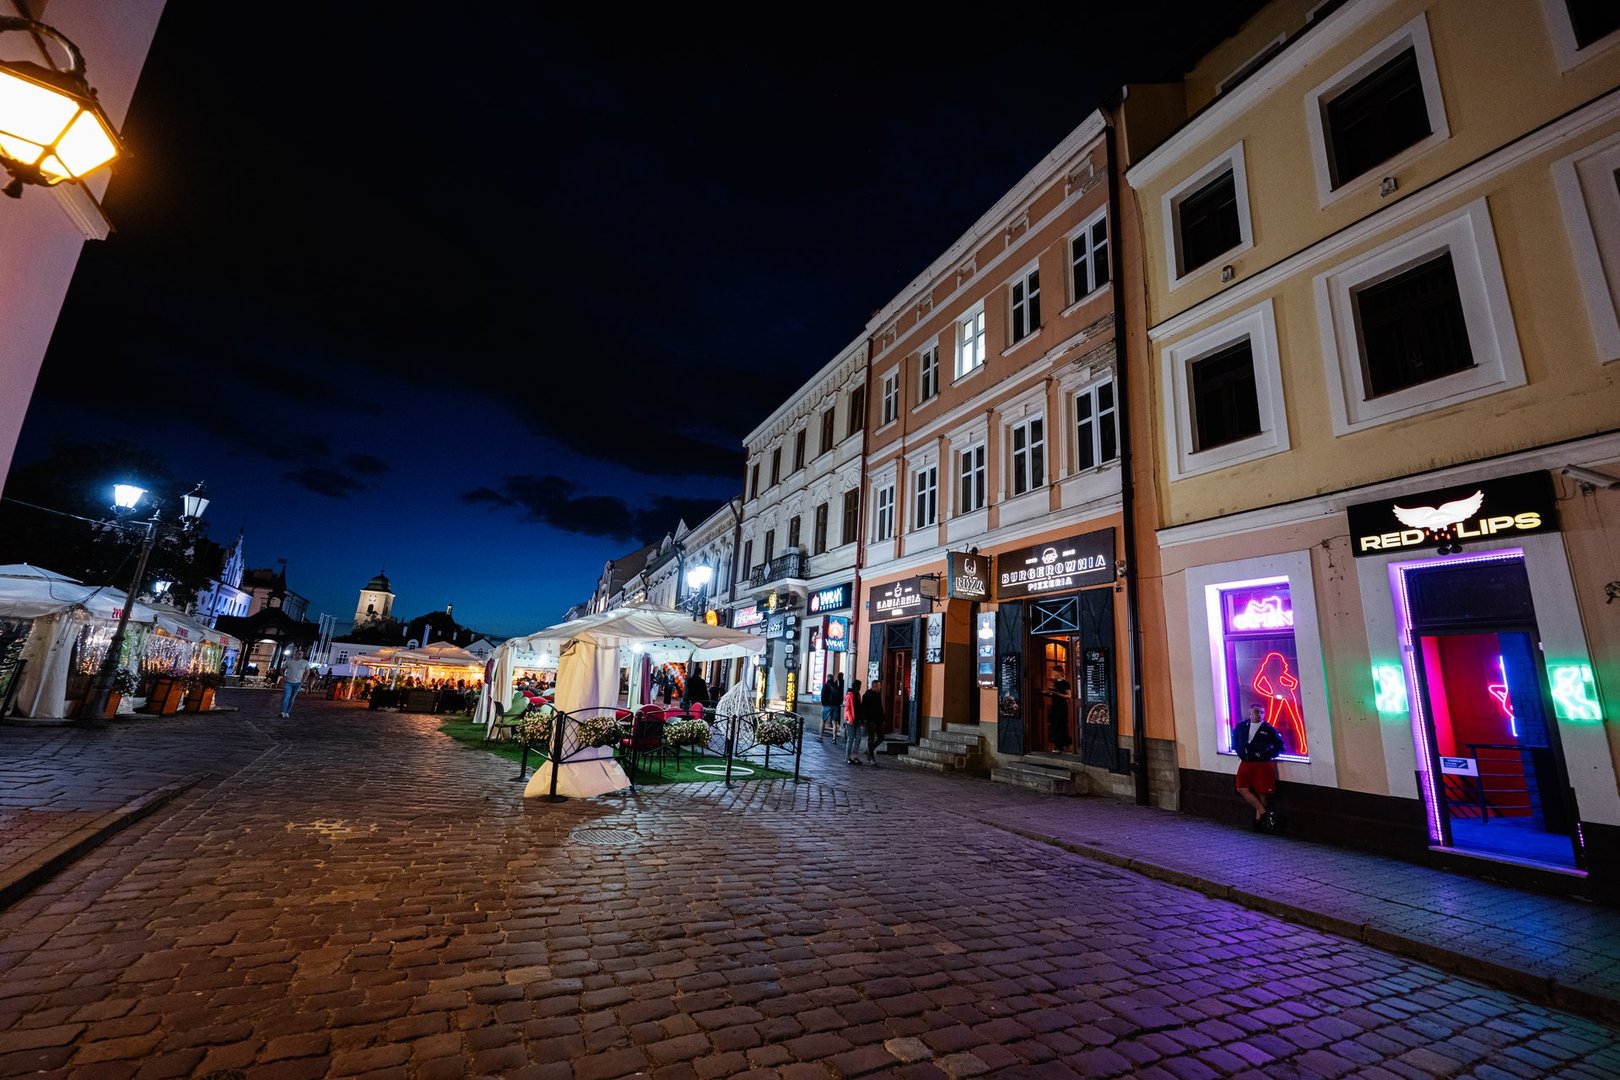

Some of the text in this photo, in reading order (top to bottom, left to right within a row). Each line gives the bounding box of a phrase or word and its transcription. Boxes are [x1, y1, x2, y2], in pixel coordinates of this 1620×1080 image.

[1360, 512, 1542, 551] RED LIPS
[1002, 555, 1106, 584] BURGEROWNIA
[1028, 577, 1072, 591] PIZZERIA
